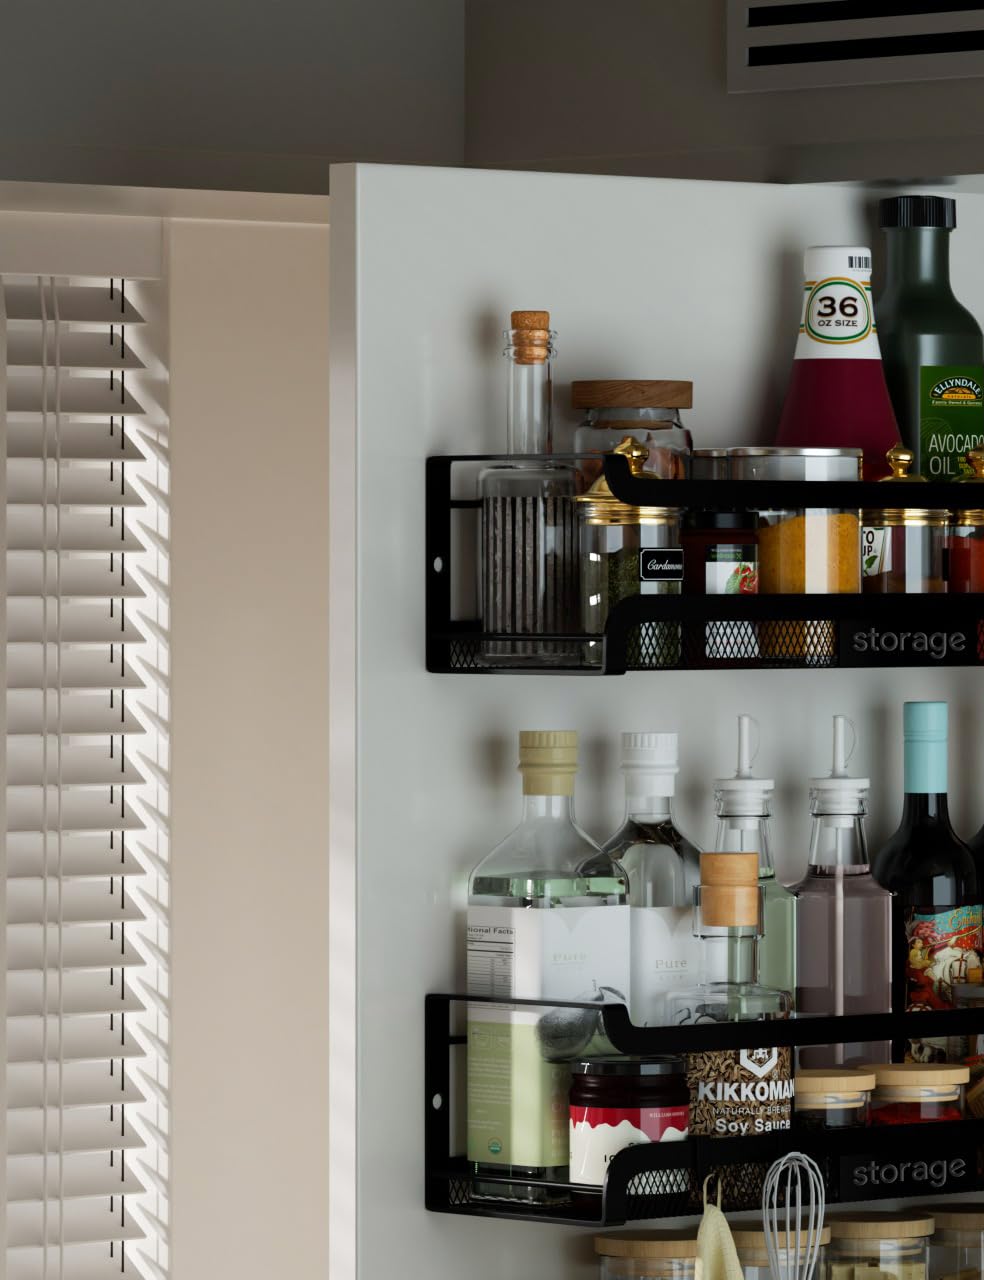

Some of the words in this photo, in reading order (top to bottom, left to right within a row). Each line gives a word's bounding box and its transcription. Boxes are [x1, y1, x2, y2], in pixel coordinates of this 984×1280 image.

[817, 296, 858, 317] 36
[817, 319, 832, 327] OZ
[834, 319, 858, 327] SIZE
[934, 378, 980, 395] ELLYNDALE
[929, 455, 956, 475] OIL
[853, 627, 966, 660] storage
[493, 927, 514, 935] Facts
[698, 1079, 795, 1102] KIKKOMAN
[712, 1105, 765, 1115] NATURALLY
[715, 1118, 748, 1136] Soy
[754, 1118, 791, 1132] Sauce
[853, 1158, 966, 1188] storage
